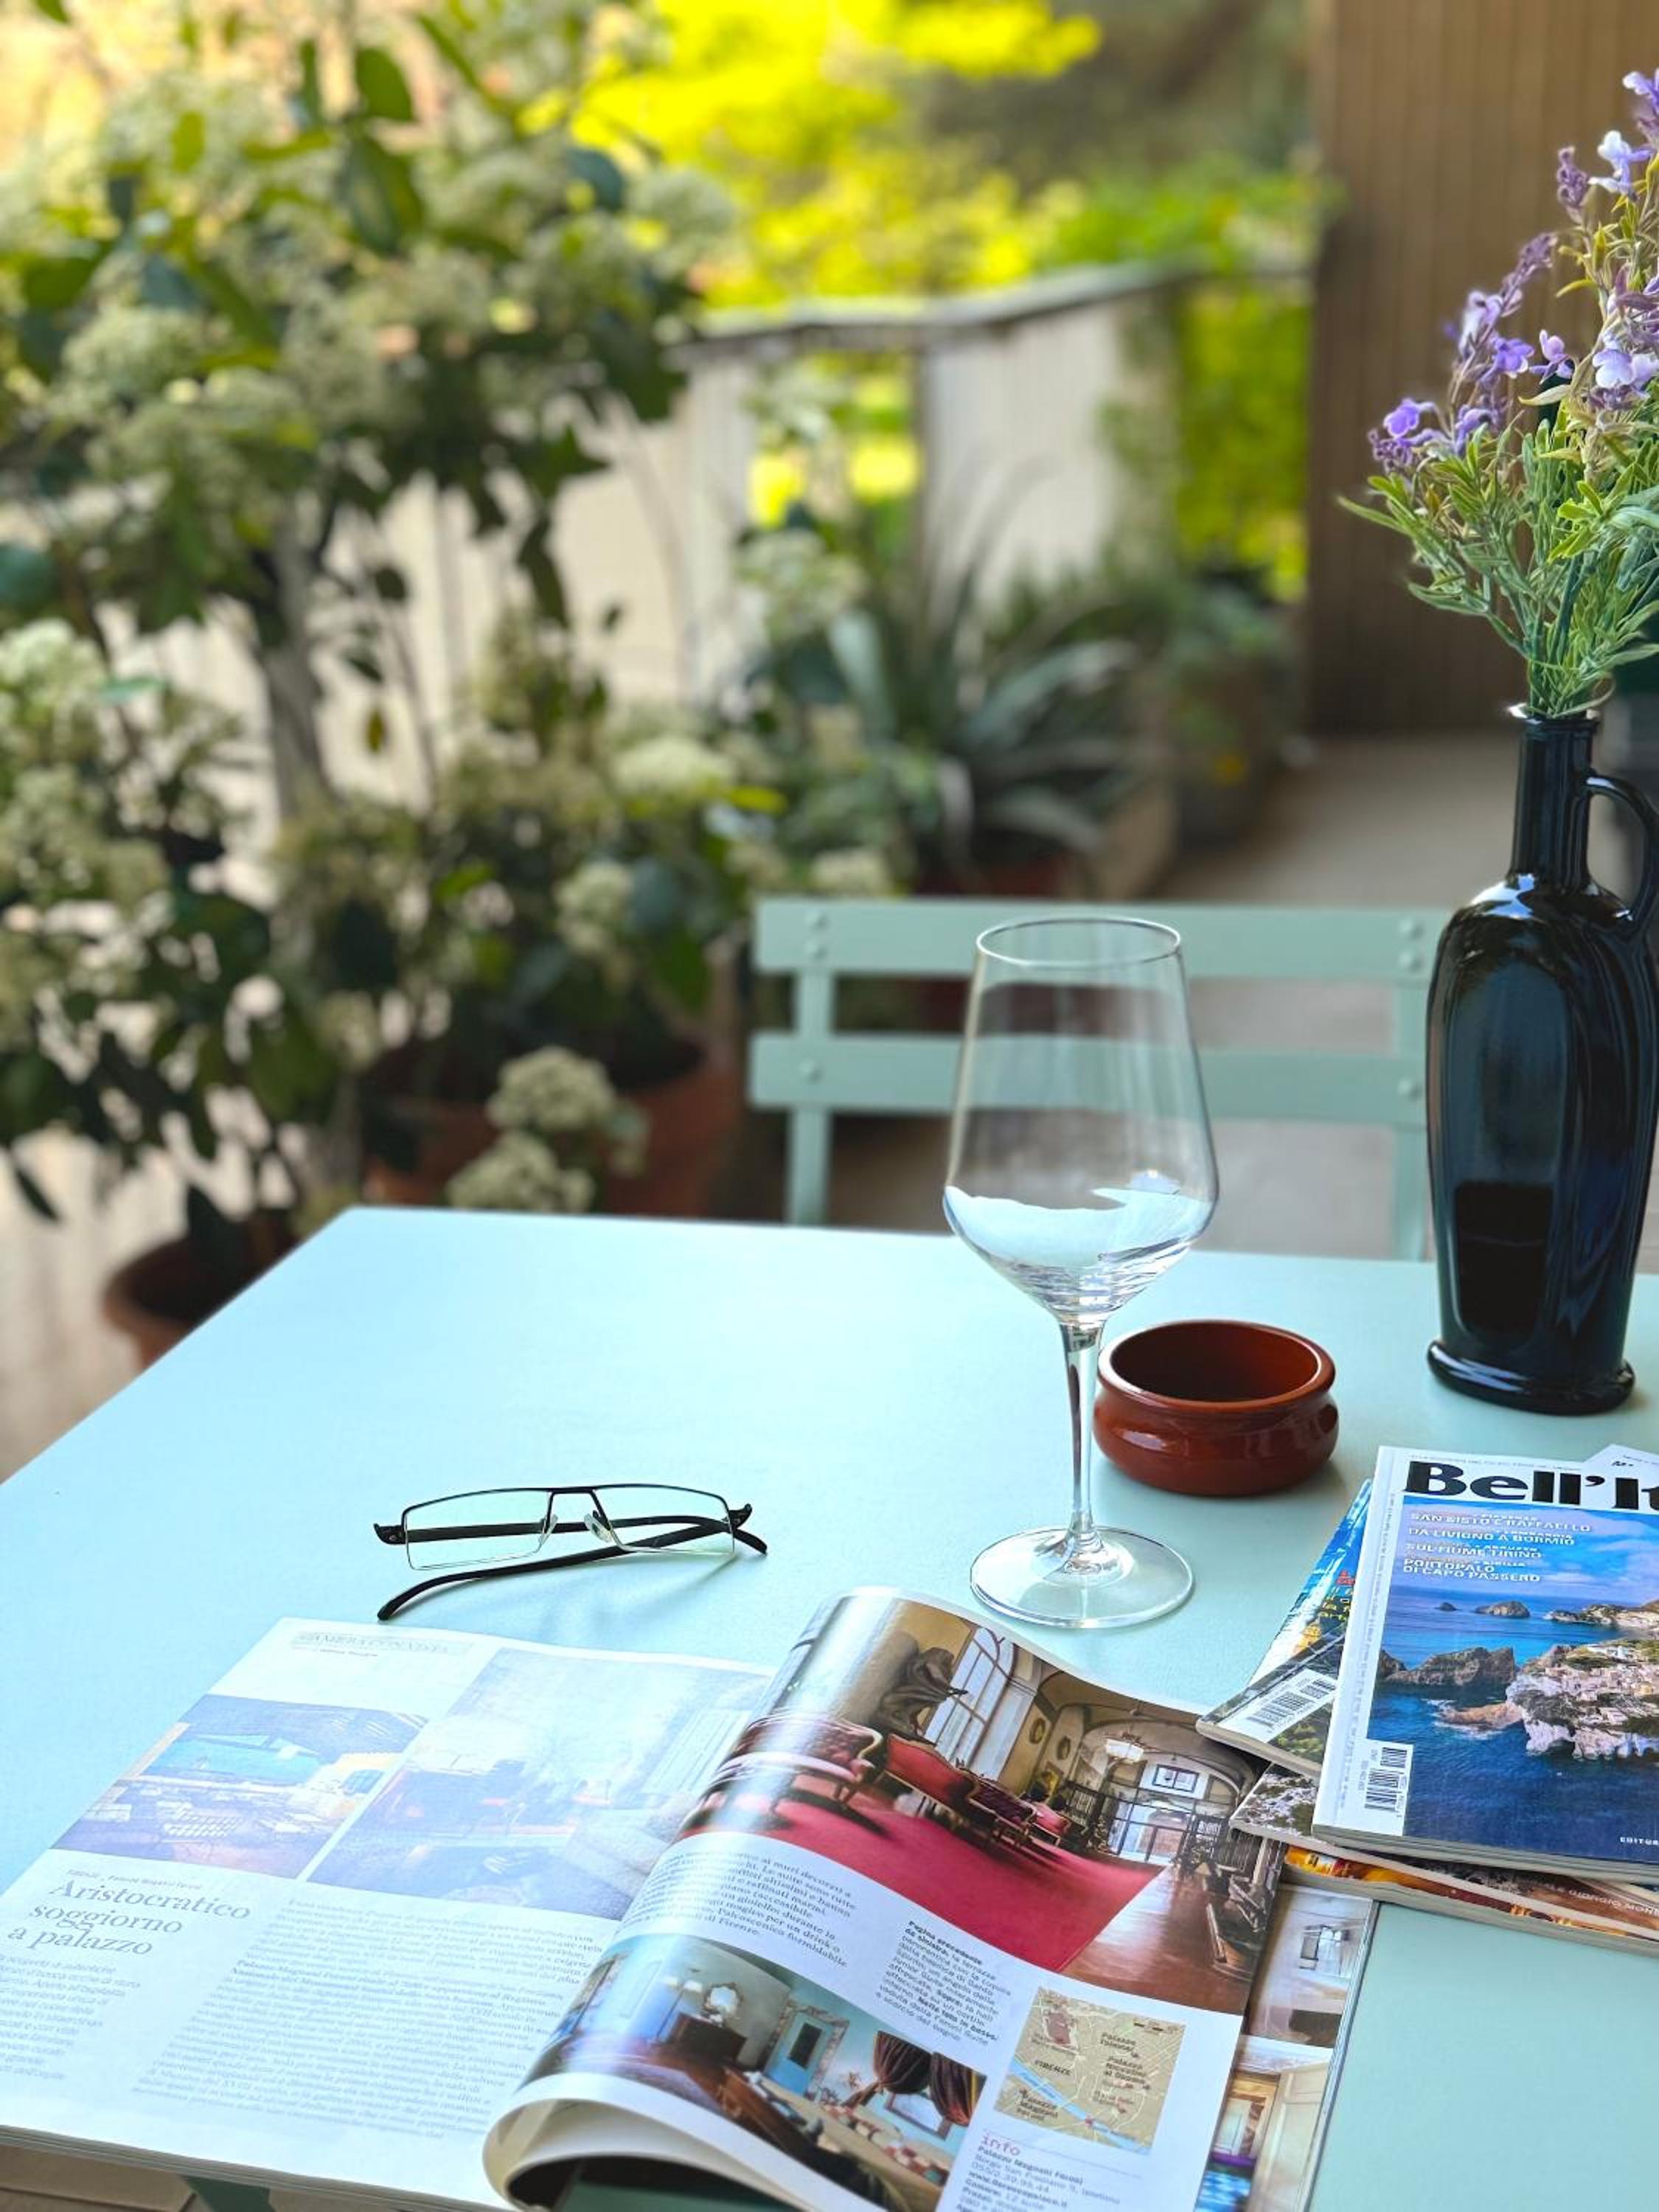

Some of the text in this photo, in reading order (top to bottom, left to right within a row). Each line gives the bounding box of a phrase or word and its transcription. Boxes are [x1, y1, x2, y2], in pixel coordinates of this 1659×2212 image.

[1433, 1530, 1495, 1540] LIVIGNO
[1498, 1532, 1509, 1541] A
[1512, 1534, 1575, 1545] BORMIO
[49, 1879, 251, 1919] Aristocratico
[29, 1904, 183, 1933] soggiorno
[7, 1927, 153, 1955] a palazzo
